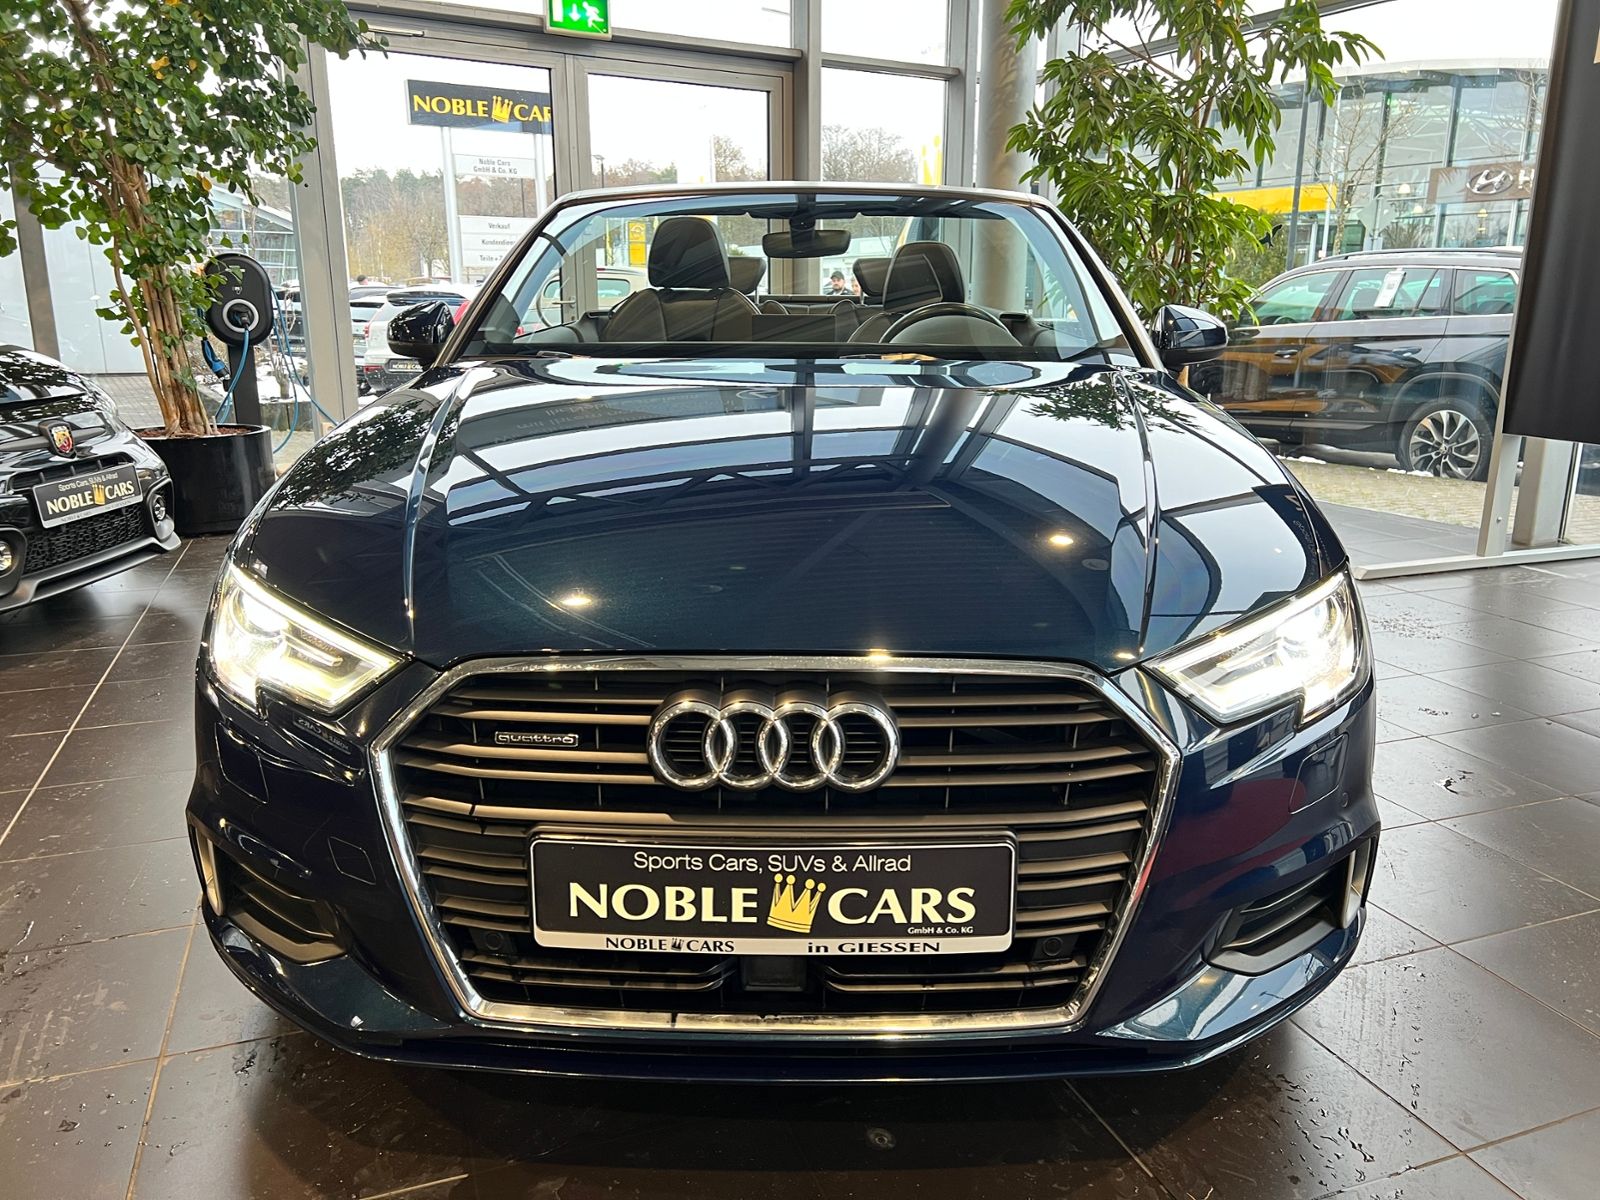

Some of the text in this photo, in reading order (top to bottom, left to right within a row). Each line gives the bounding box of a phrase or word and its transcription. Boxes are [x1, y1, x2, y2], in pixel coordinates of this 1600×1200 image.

[413, 95, 489, 117] NOBLE
[479, 158, 495, 166] Noble
[46, 481, 134, 515] NOBLE CARS
[498, 734, 574, 744] quattro
[633, 851, 912, 874] Sports Cars, SUVs & Allrad
[569, 882, 976, 924] NOBLE CARS
[907, 926, 974, 934] GmbH & Co. KG
[606, 937, 940, 953] NOBLE CARS in GIESSEN
